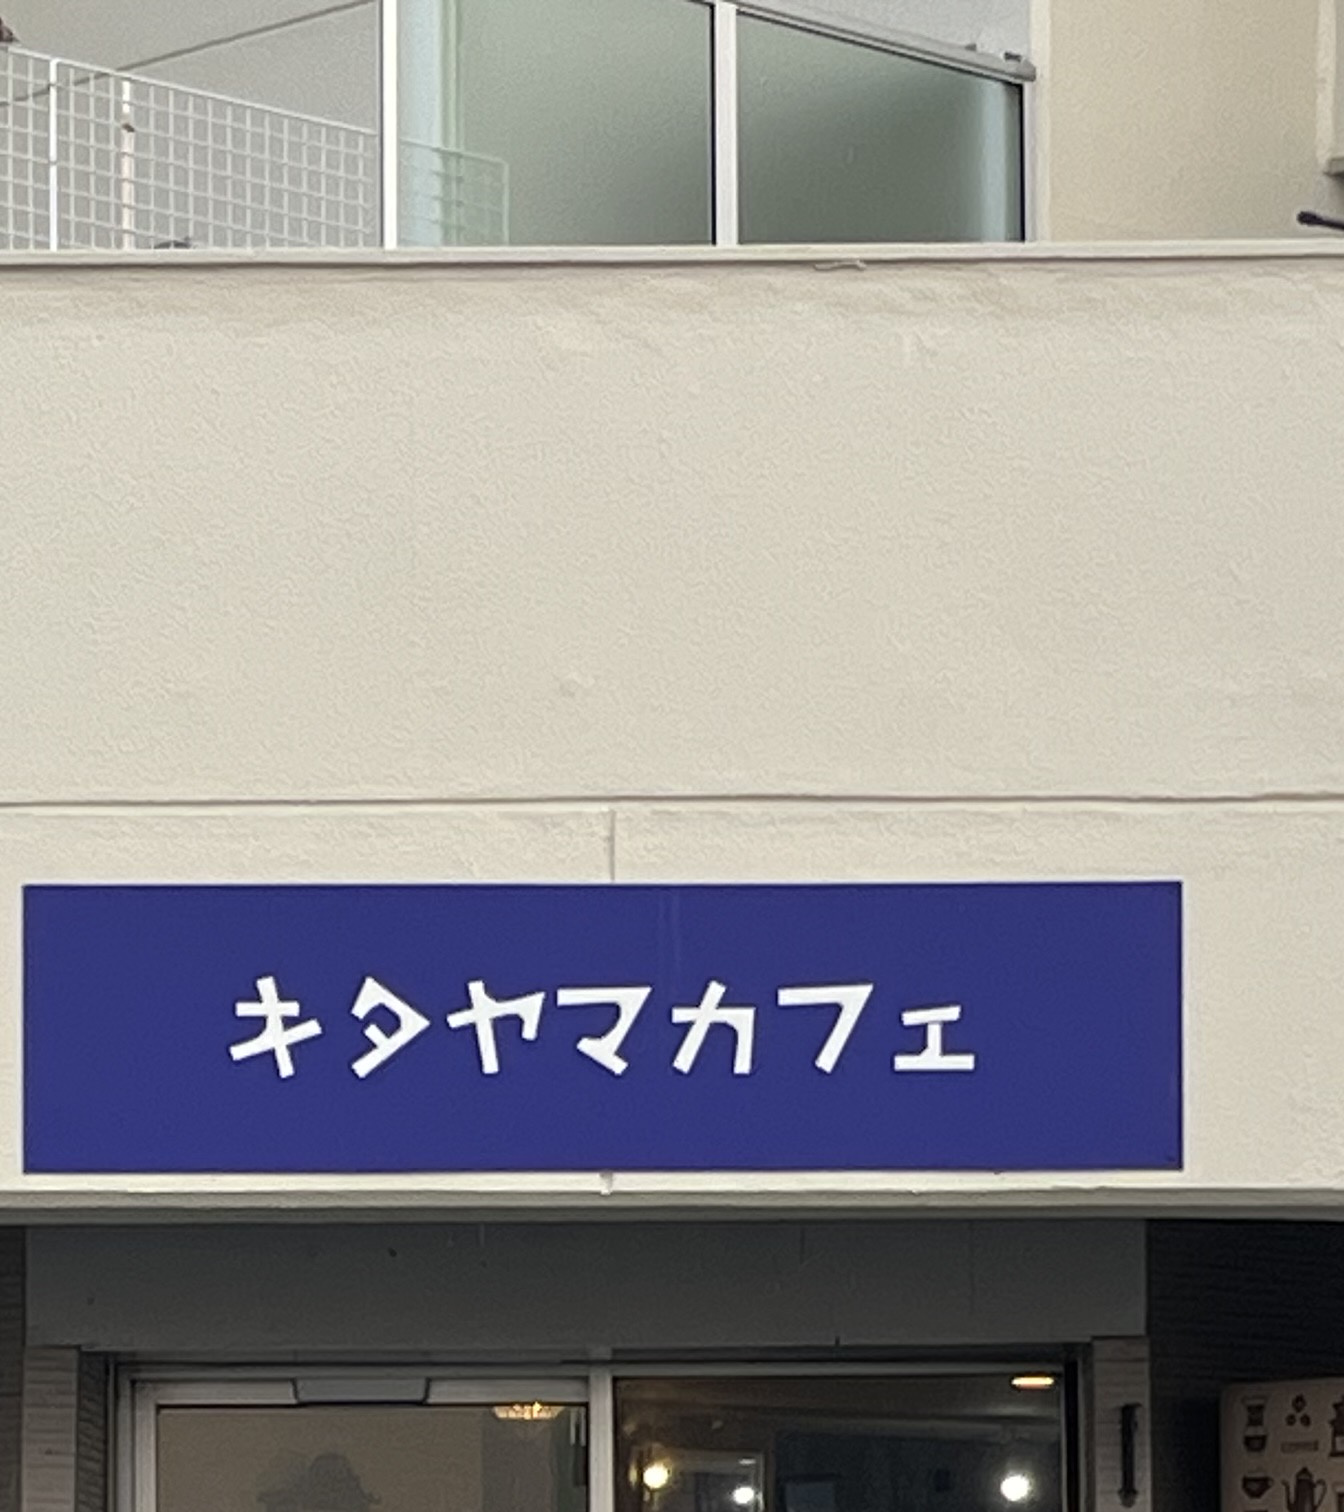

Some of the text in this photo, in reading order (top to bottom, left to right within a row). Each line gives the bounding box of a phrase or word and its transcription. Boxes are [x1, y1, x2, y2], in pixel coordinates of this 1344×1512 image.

[230, 976, 974, 1078] キタヤマカフェ
